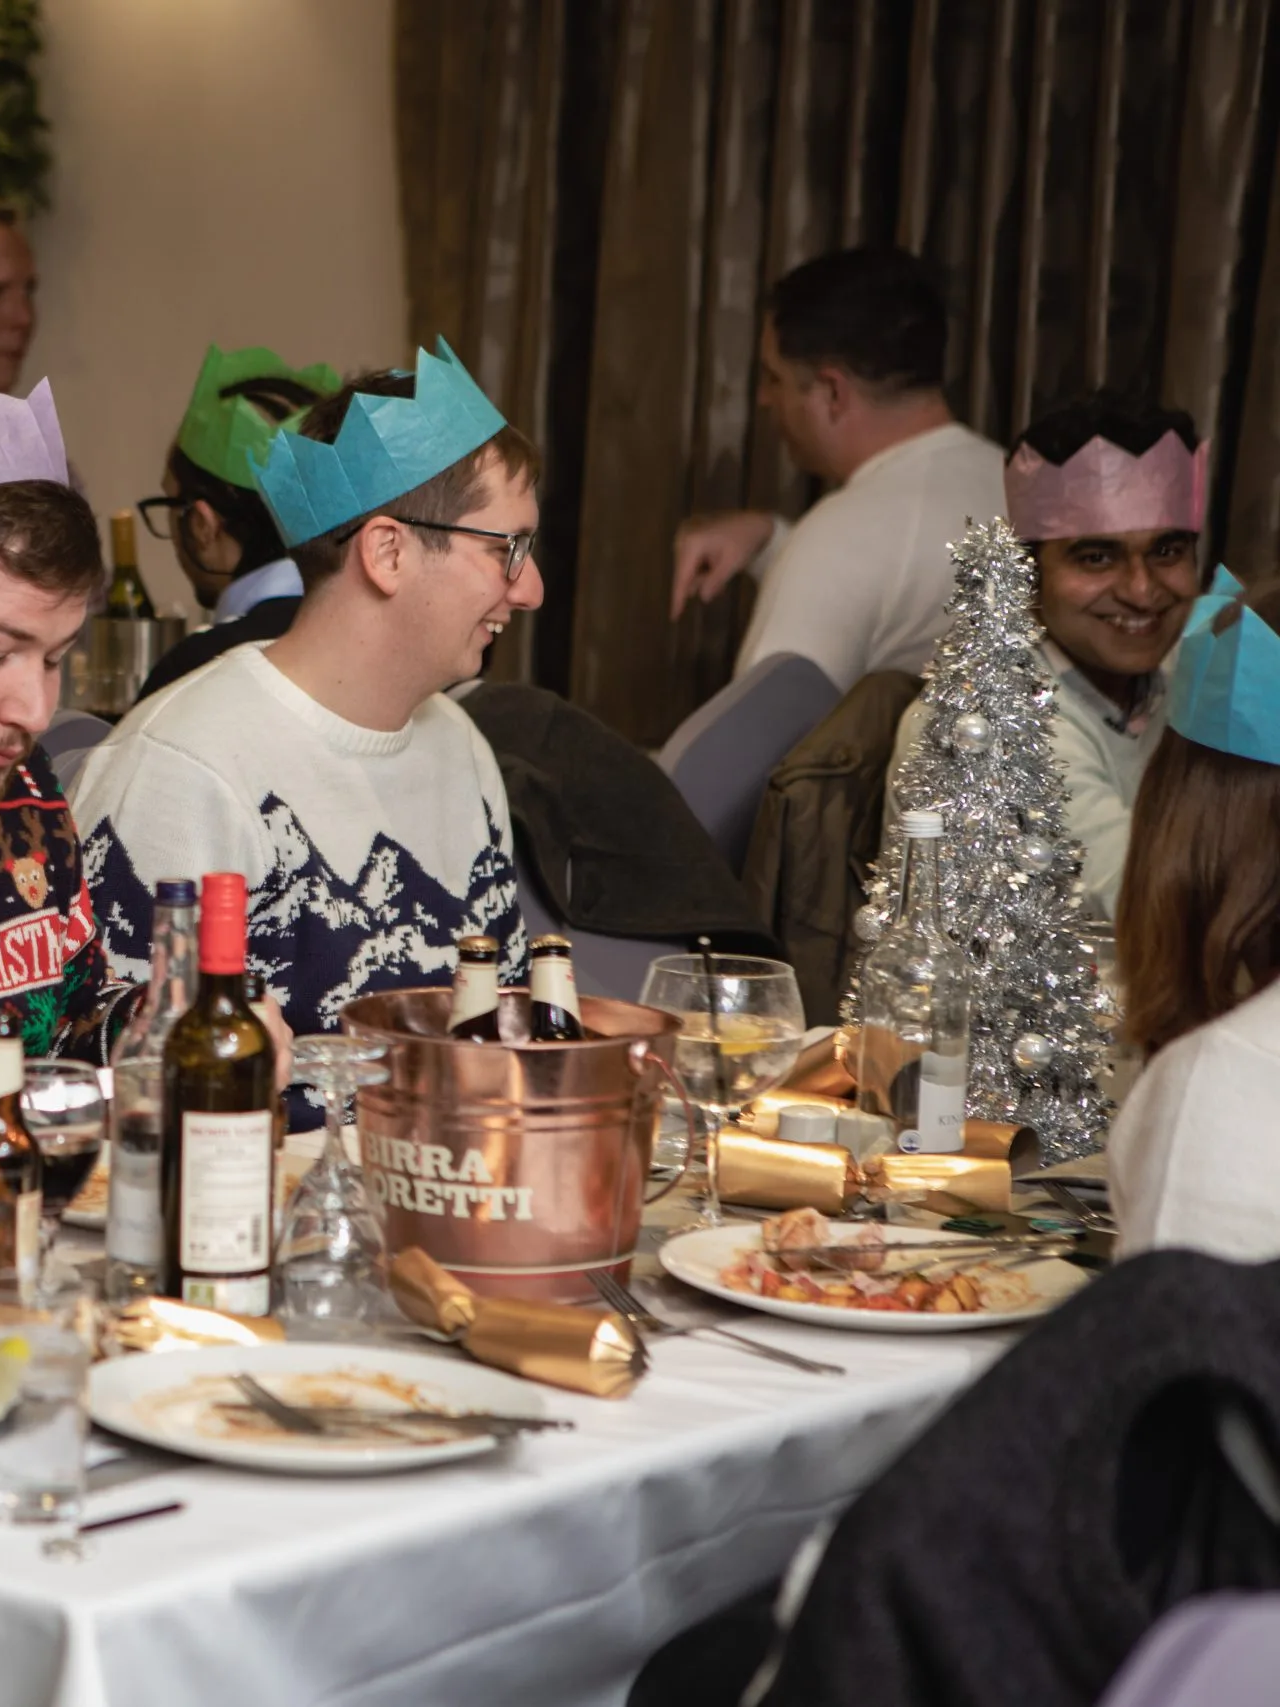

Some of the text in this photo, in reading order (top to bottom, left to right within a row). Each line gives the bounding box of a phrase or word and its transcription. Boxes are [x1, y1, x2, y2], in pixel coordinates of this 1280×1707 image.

[939, 1114, 964, 1126] KIN
[364, 1132, 493, 1183] BIRRA
[366, 1168, 534, 1221] ORETTI
